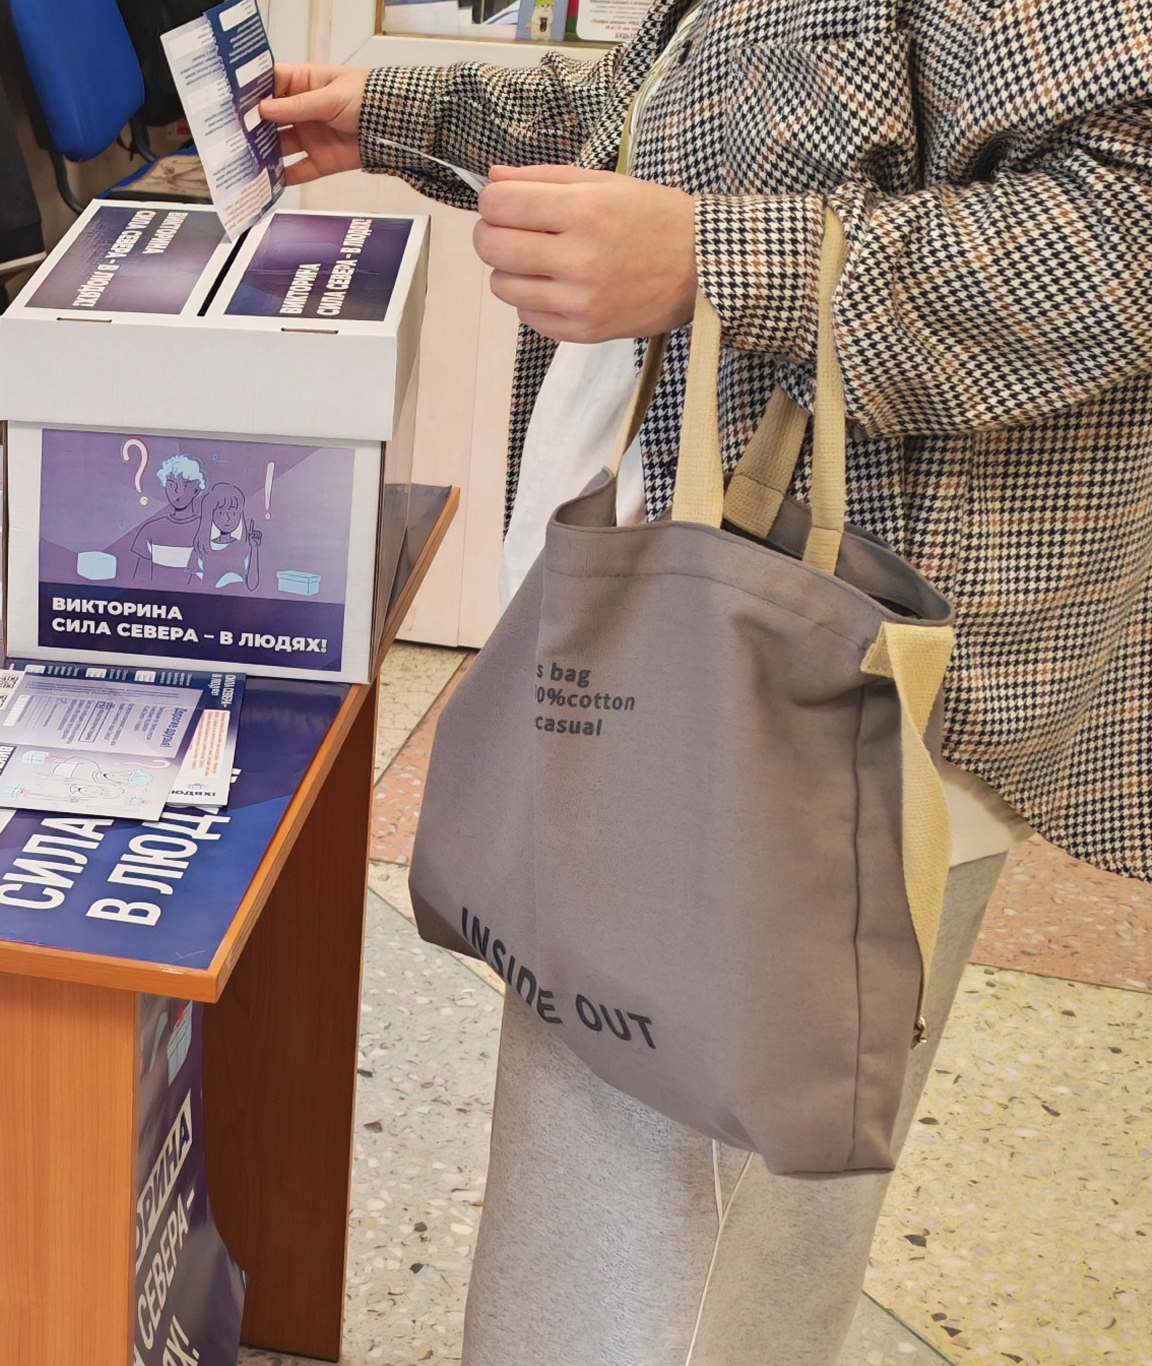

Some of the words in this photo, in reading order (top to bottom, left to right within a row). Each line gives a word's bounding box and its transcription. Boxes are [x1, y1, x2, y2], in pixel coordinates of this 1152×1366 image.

[125, 210, 157, 230] СИЛА
[142, 211, 189, 254] ВИКТОРИНА
[342, 218, 373, 248] ЛЮДЯХ!
[105, 230, 143, 259] СЕВЕРА
[279, 263, 322, 314] ВИКТОРИНА
[325, 259, 359, 290] СЕВЕРА
[71, 271, 115, 308] ЛЮДЯХ!
[316, 291, 347, 316] СИЛА
[52, 597, 183, 621] ВИКТОРИНА
[52, 617, 112, 636] СИЛА
[116, 622, 199, 643] СЕВЕРА
[219, 631, 233, 646] В
[238, 632, 328, 654] ЛЮДЯХ!
[550, 661, 592, 688] bag
[535, 685, 635, 711] 0%cotton
[535, 716, 603, 737] casual
[85, 897, 162, 926] В
[461, 906, 563, 1024] INSIDE
[575, 993, 657, 1050] OUT
[137, 1192, 189, 1351] СЕВЕРА
